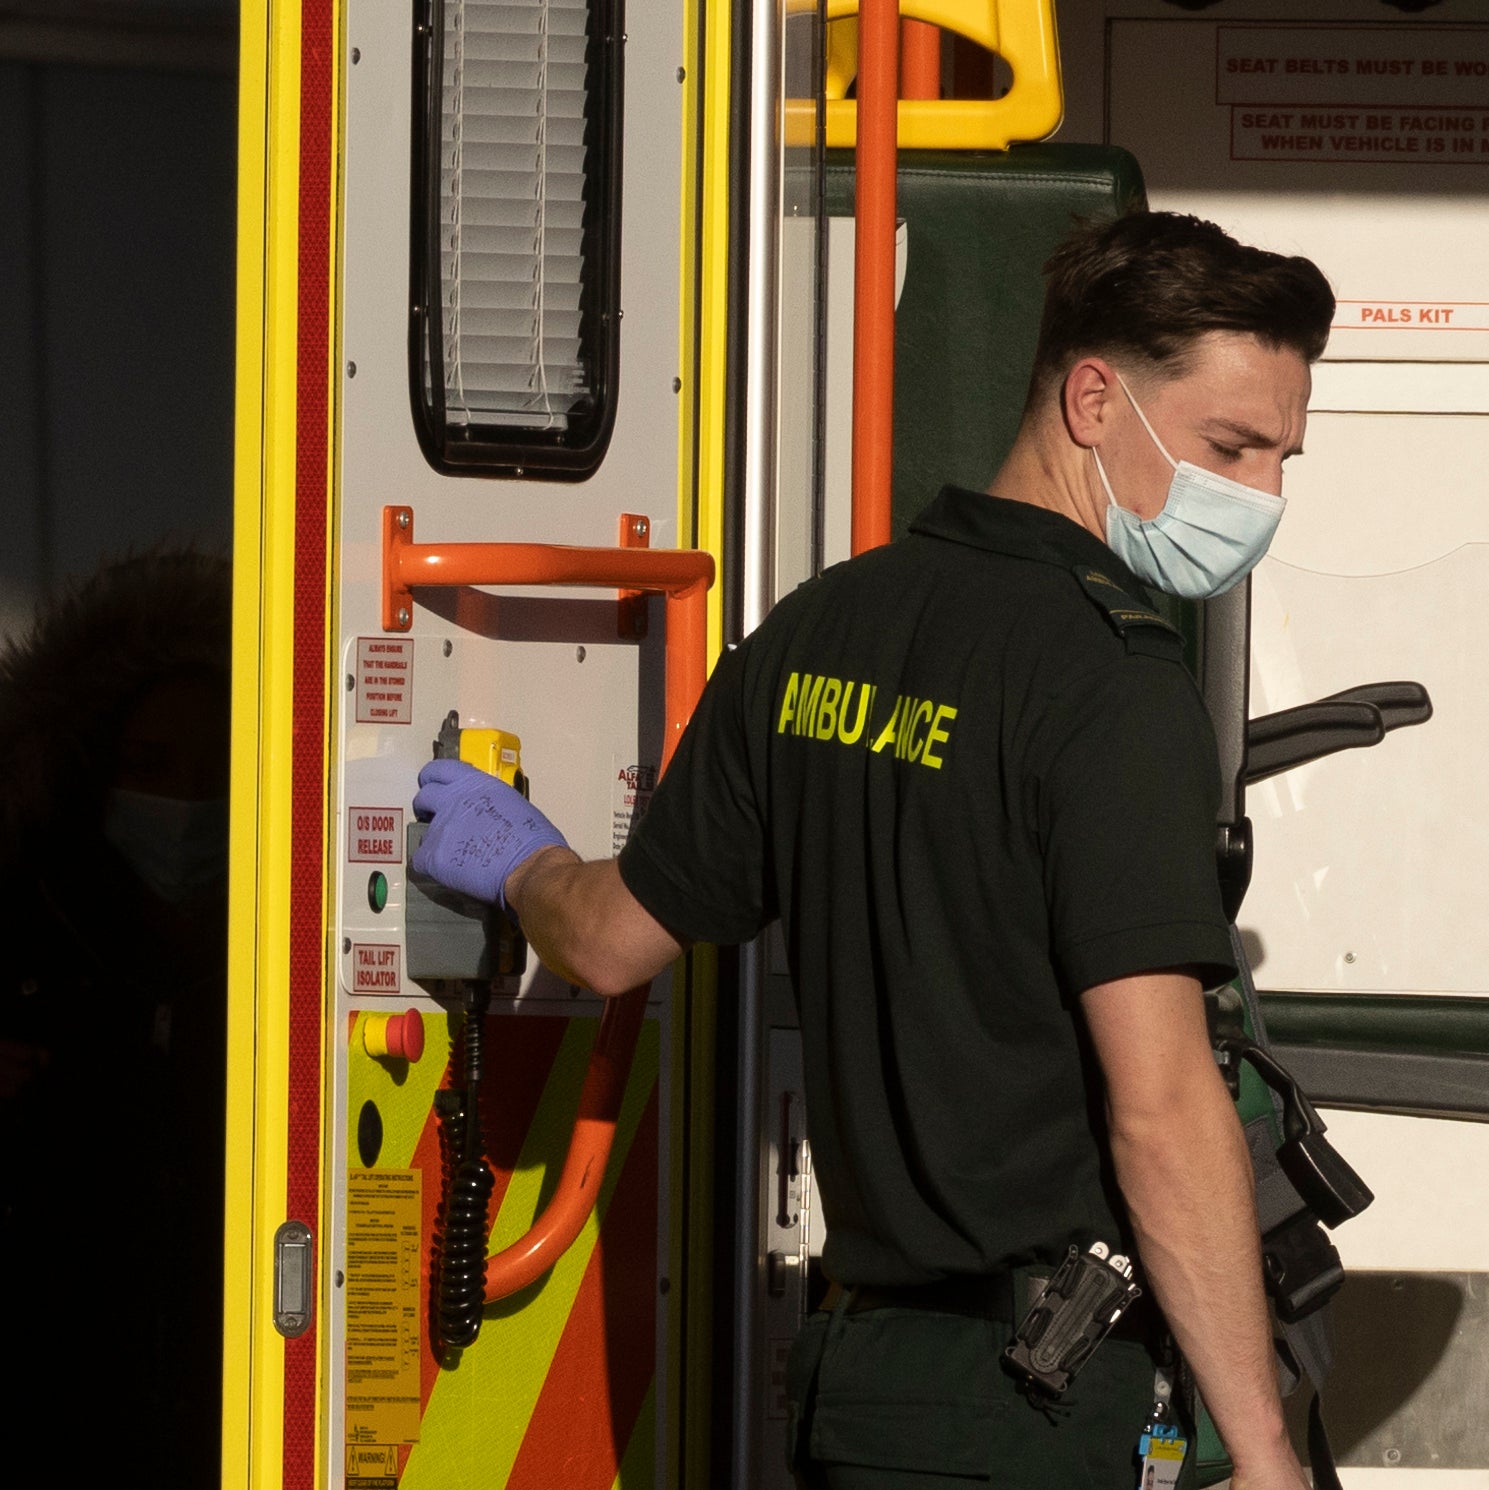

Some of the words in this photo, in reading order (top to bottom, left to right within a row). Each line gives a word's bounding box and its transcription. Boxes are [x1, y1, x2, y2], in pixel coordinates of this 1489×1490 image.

[1226, 58, 1279, 73] SEAT
[1285, 58, 1350, 74] BELTS
[1356, 59, 1415, 75] MUST
[1421, 60, 1449, 76] BE
[1241, 113, 1294, 129] SEAT
[1300, 114, 1360, 130] MUST
[1365, 115, 1393, 131] BE
[1399, 116, 1475, 131] FACING
[1261, 135, 1323, 150] WHEN
[1329, 136, 1419, 152] VEHICLE
[1426, 137, 1445, 153] IS
[1452, 138, 1474, 153] IN
[1361, 308, 1412, 323] PALS
[1419, 308, 1454, 323] KIT
[777, 671, 959, 770] AMBUANCE
[357, 815, 370, 831] O/S
[372, 815, 395, 832] DOOR
[357, 838, 393, 855] RELEASE
[358, 950, 376, 966] TAIL
[378, 950, 395, 966] LIFT
[357, 970, 396, 987] ISOLATOR
